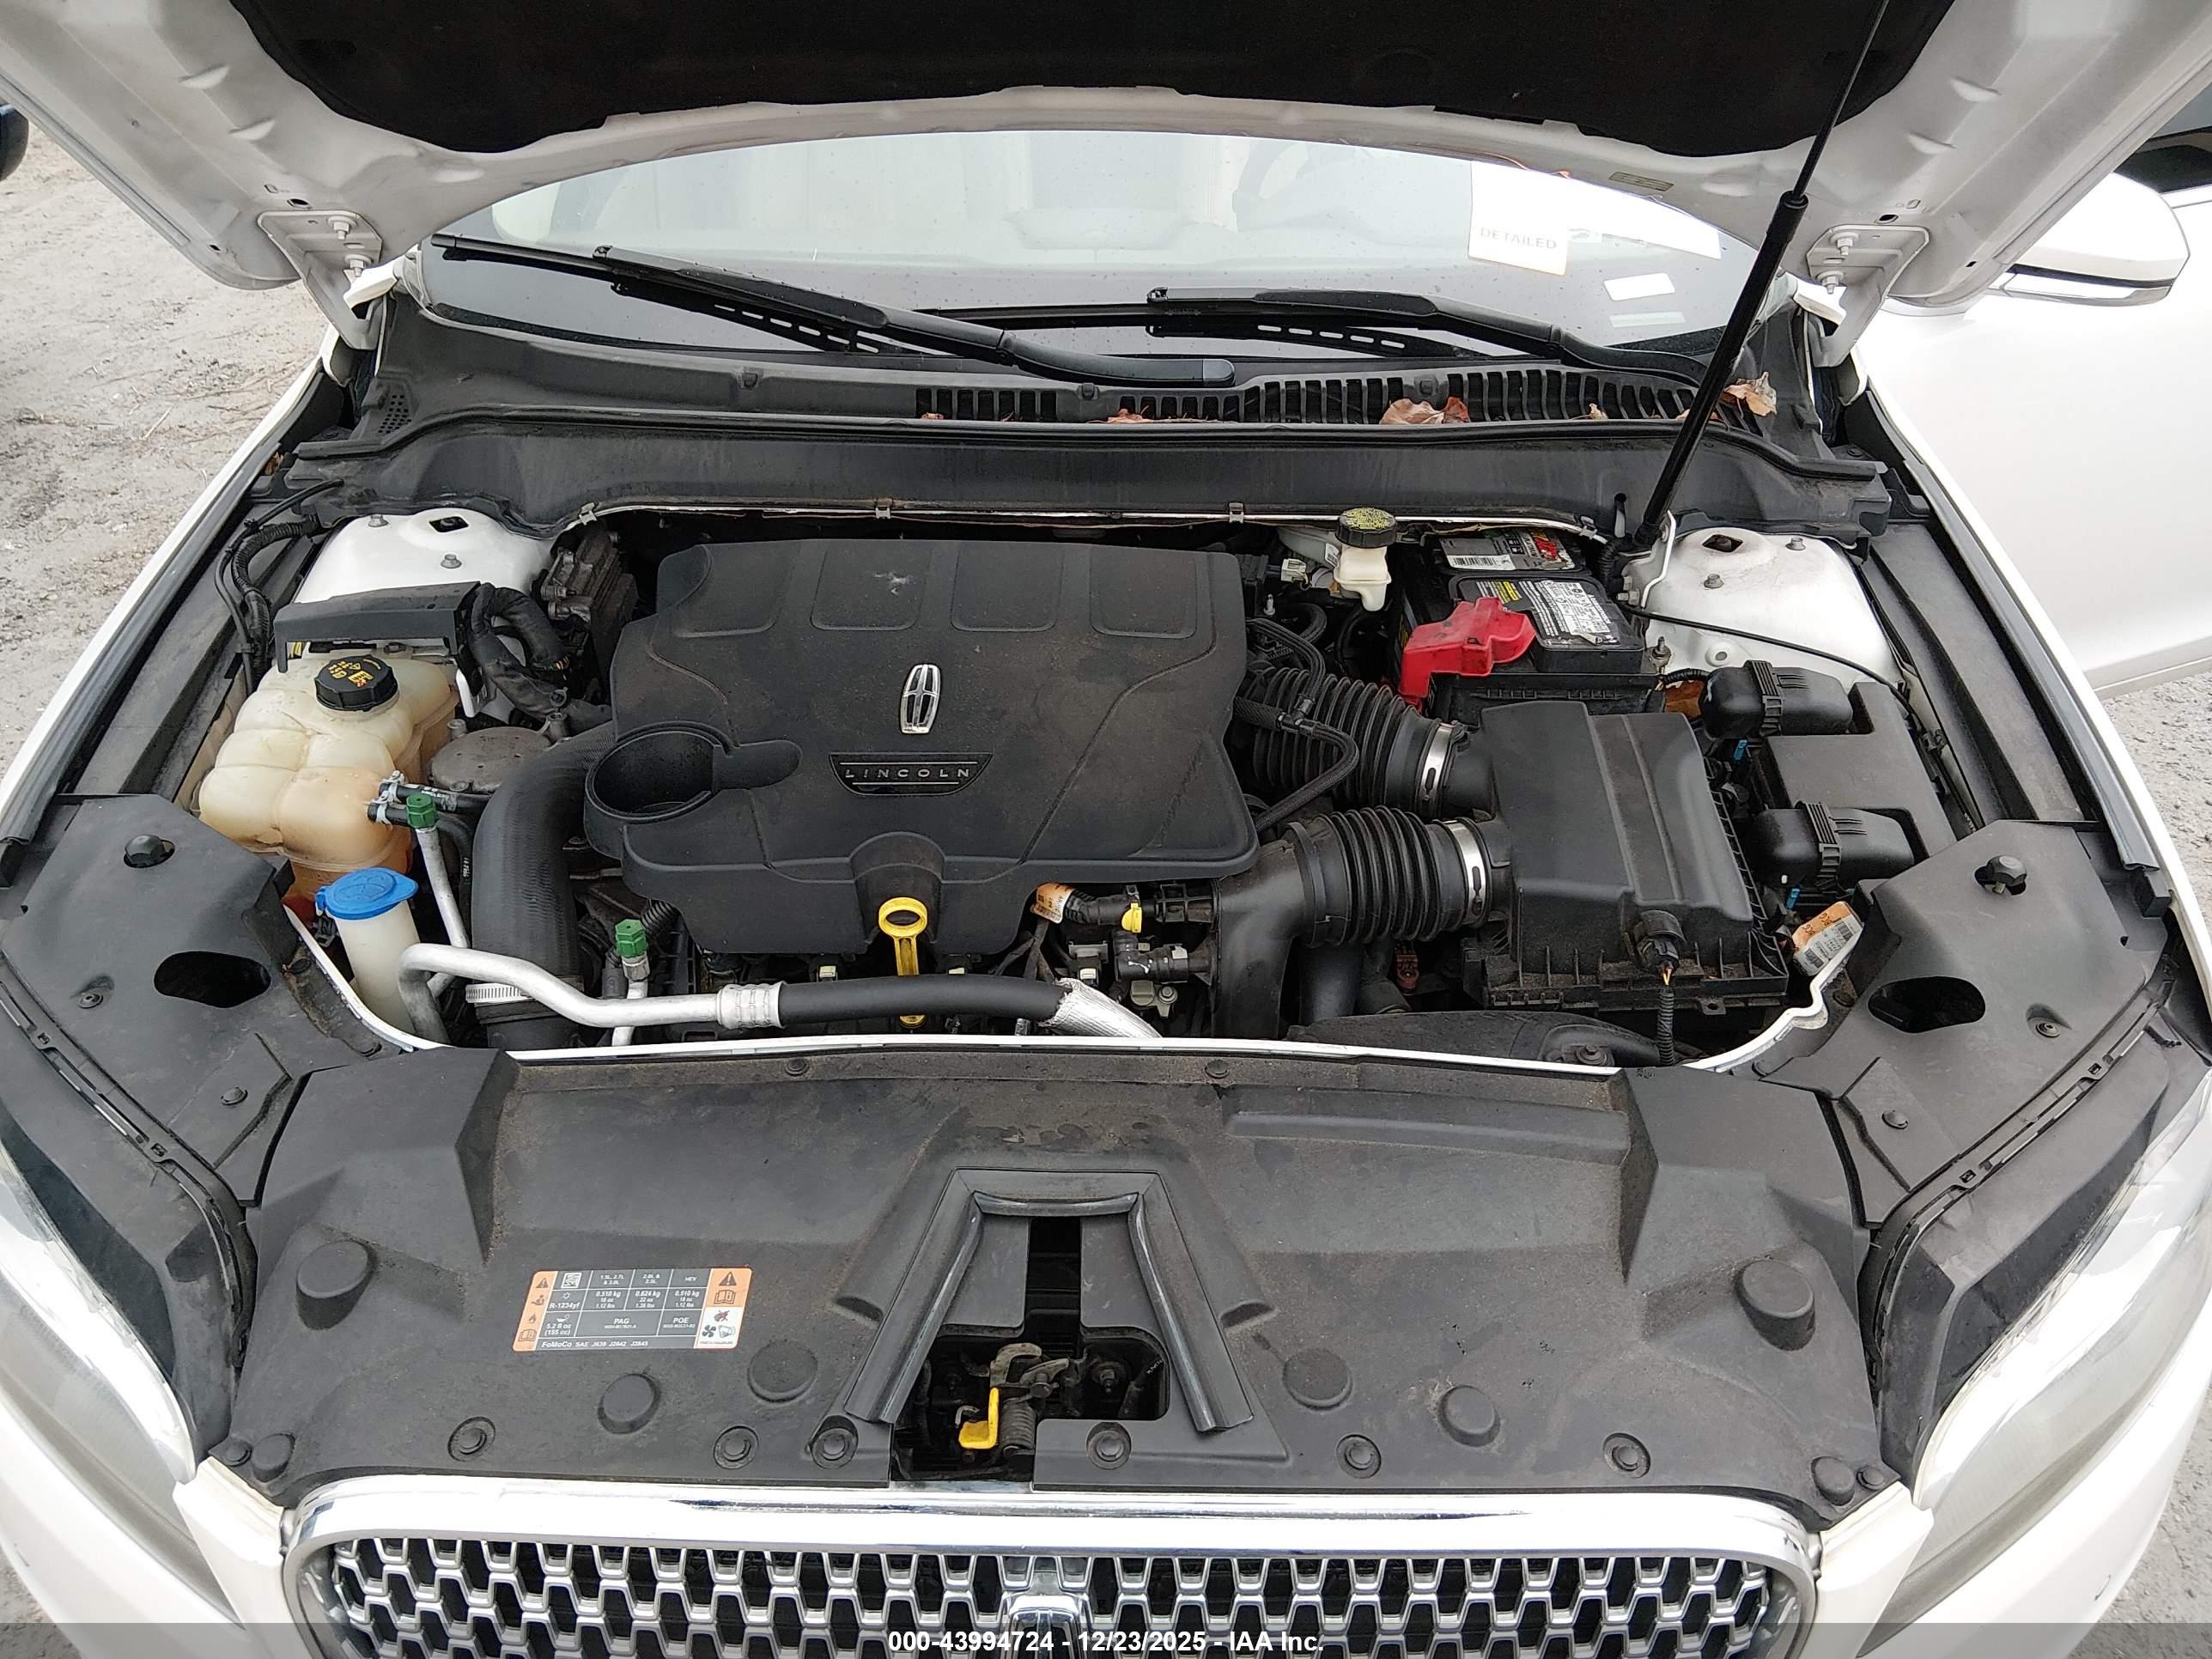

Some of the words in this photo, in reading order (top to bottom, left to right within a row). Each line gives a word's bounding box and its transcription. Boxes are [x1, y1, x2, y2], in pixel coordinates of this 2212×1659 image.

[1480, 226, 1557, 249] DETAILED
[845, 768, 969, 779] LINCOLN
[653, 1290, 661, 1298] kg
